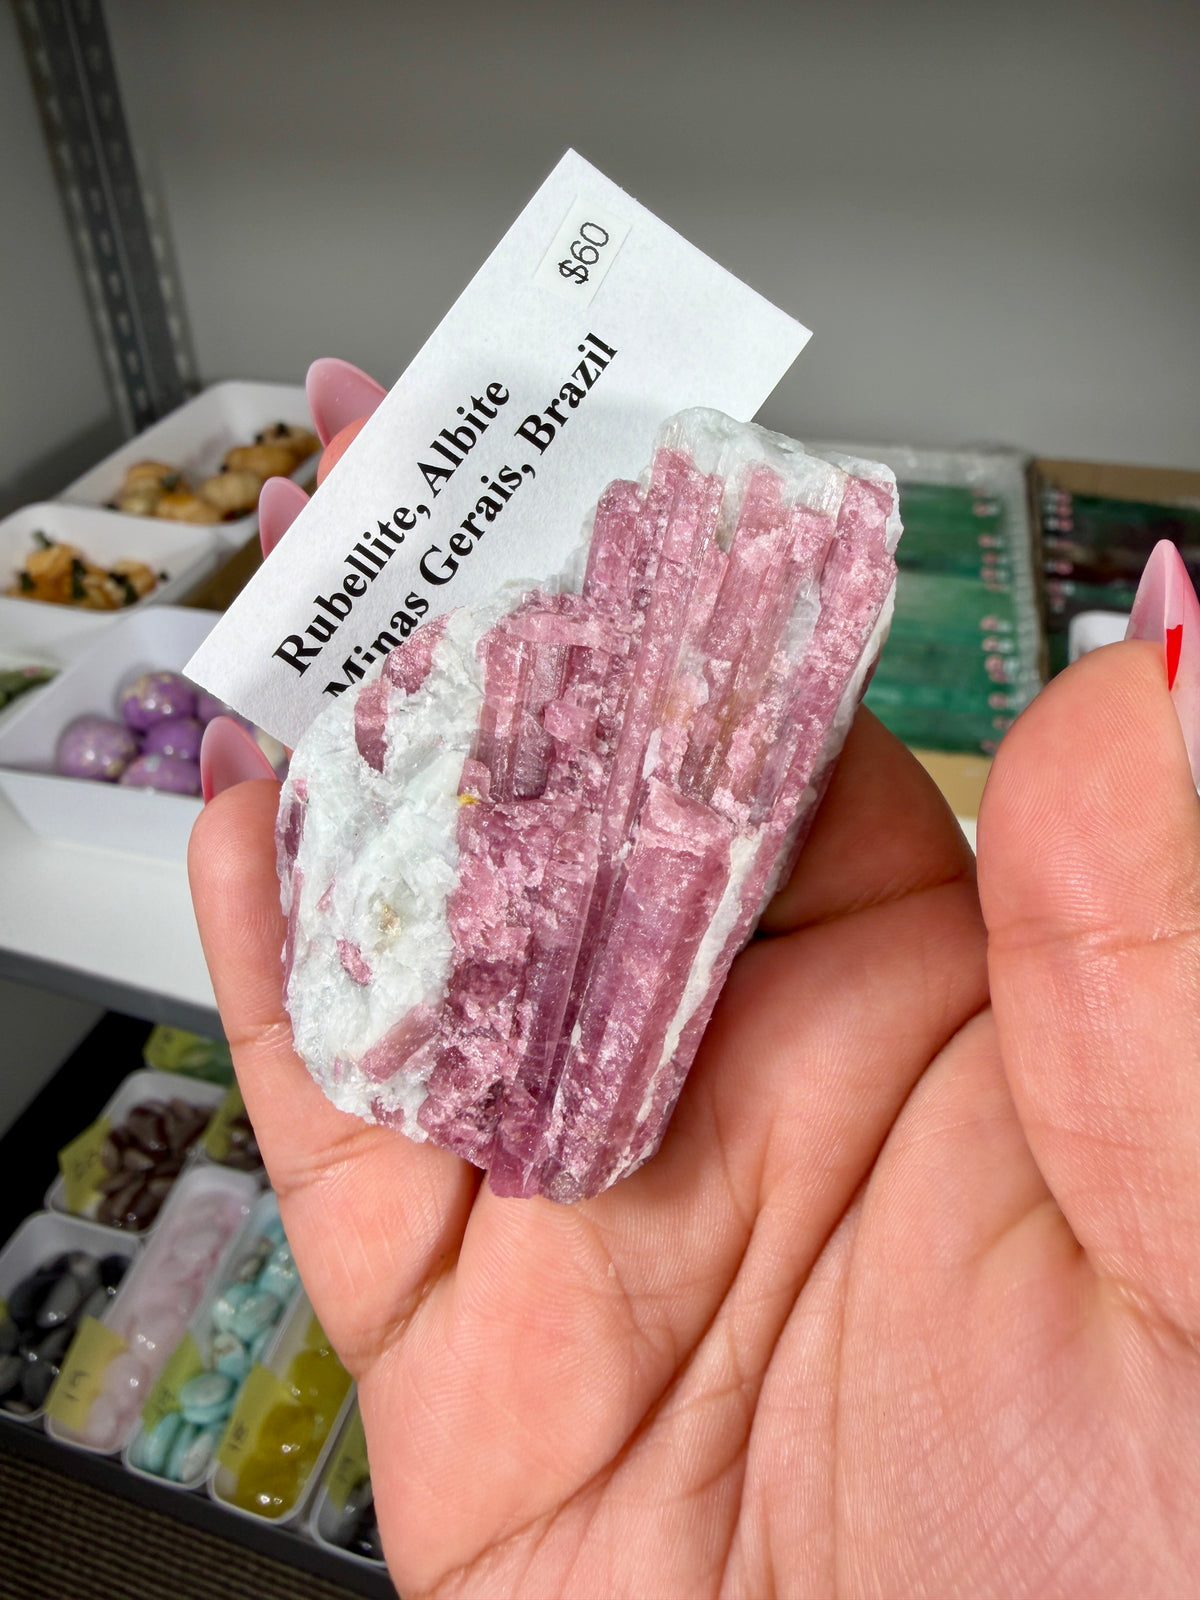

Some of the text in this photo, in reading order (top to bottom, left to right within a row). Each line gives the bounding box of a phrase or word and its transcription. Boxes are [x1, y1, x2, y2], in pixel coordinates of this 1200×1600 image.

[558, 222, 609, 285] $60
[272, 383, 510, 678] Rubellite, Albite
[420, 464, 536, 586] Gerais,
[513, 333, 618, 456] Brazil
